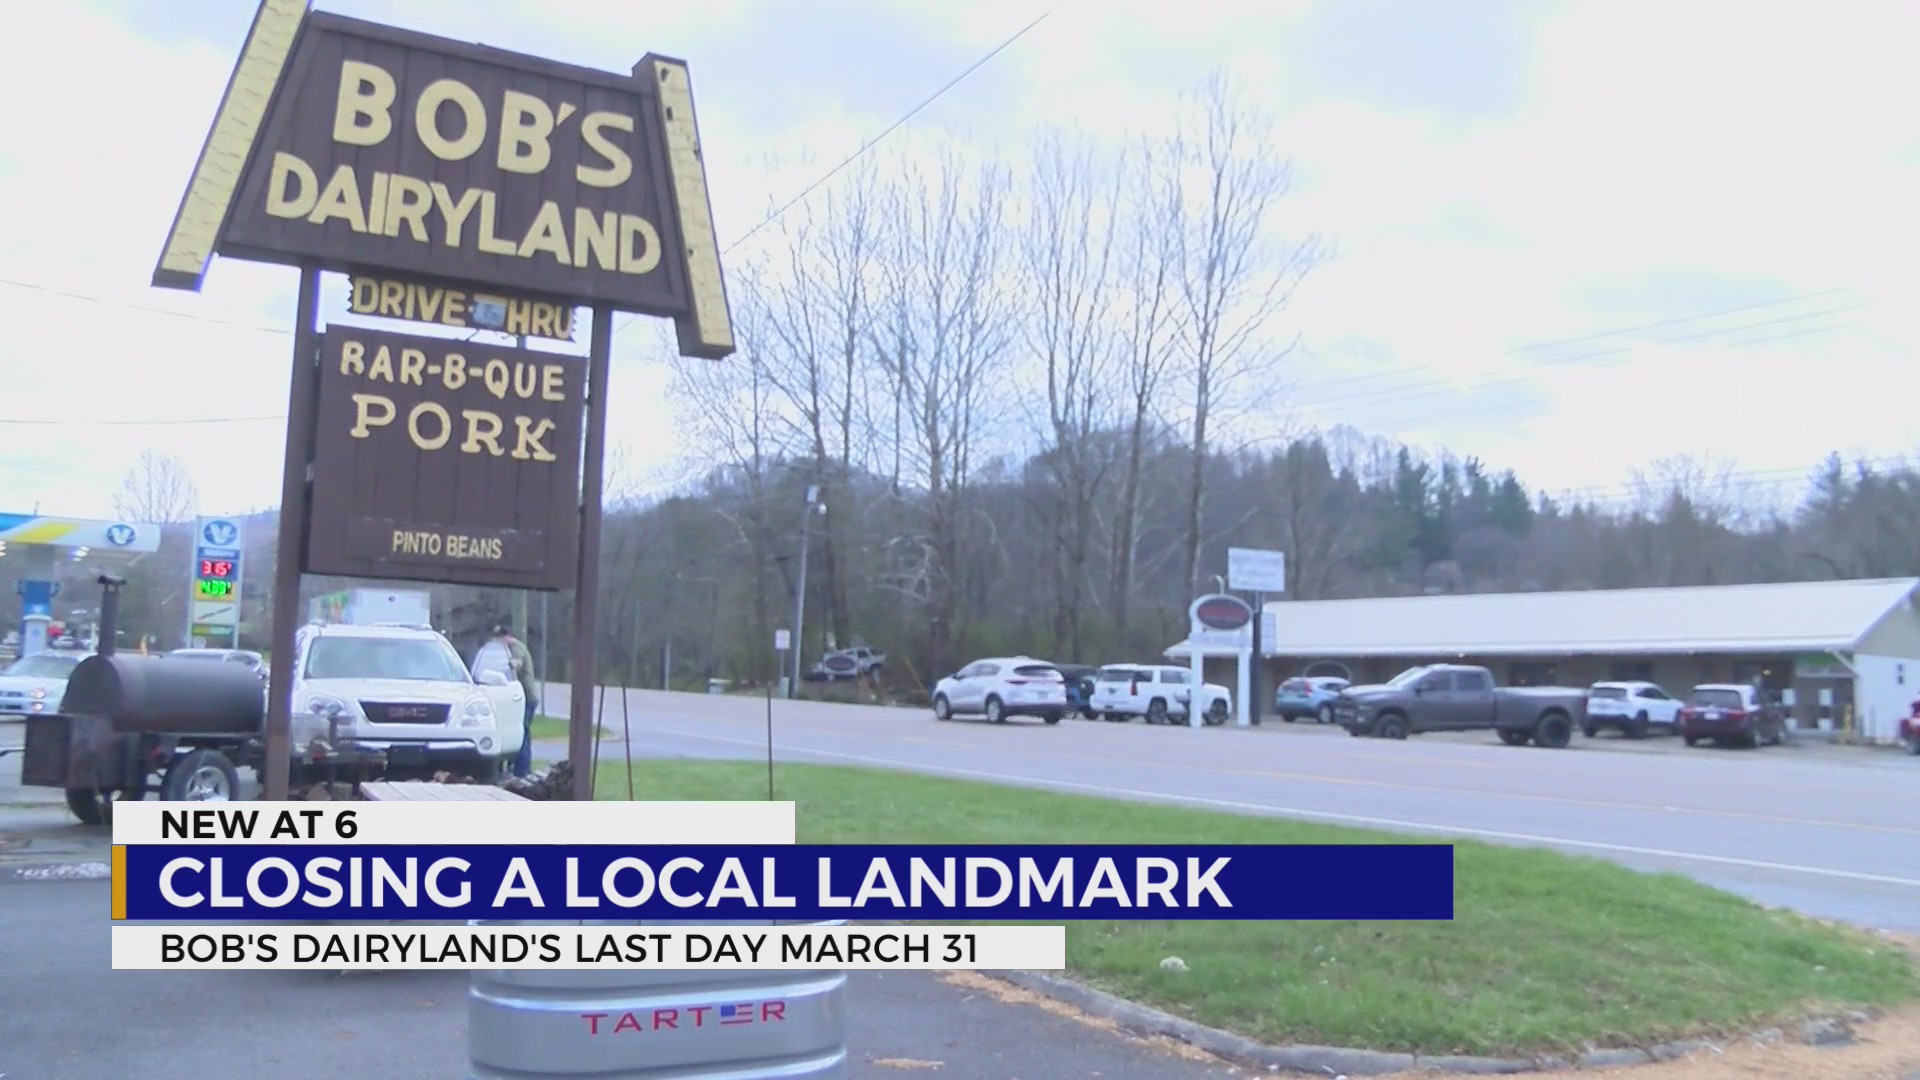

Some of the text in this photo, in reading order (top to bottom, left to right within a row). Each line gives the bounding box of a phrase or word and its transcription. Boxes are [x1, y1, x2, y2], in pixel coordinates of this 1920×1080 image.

[332, 59, 635, 188] BOB'S
[265, 152, 662, 275] DAIRYLAND
[350, 393, 557, 462] PORK
[392, 530, 502, 559] PINTO BEANS
[581, 1000, 787, 1035] TARTER
